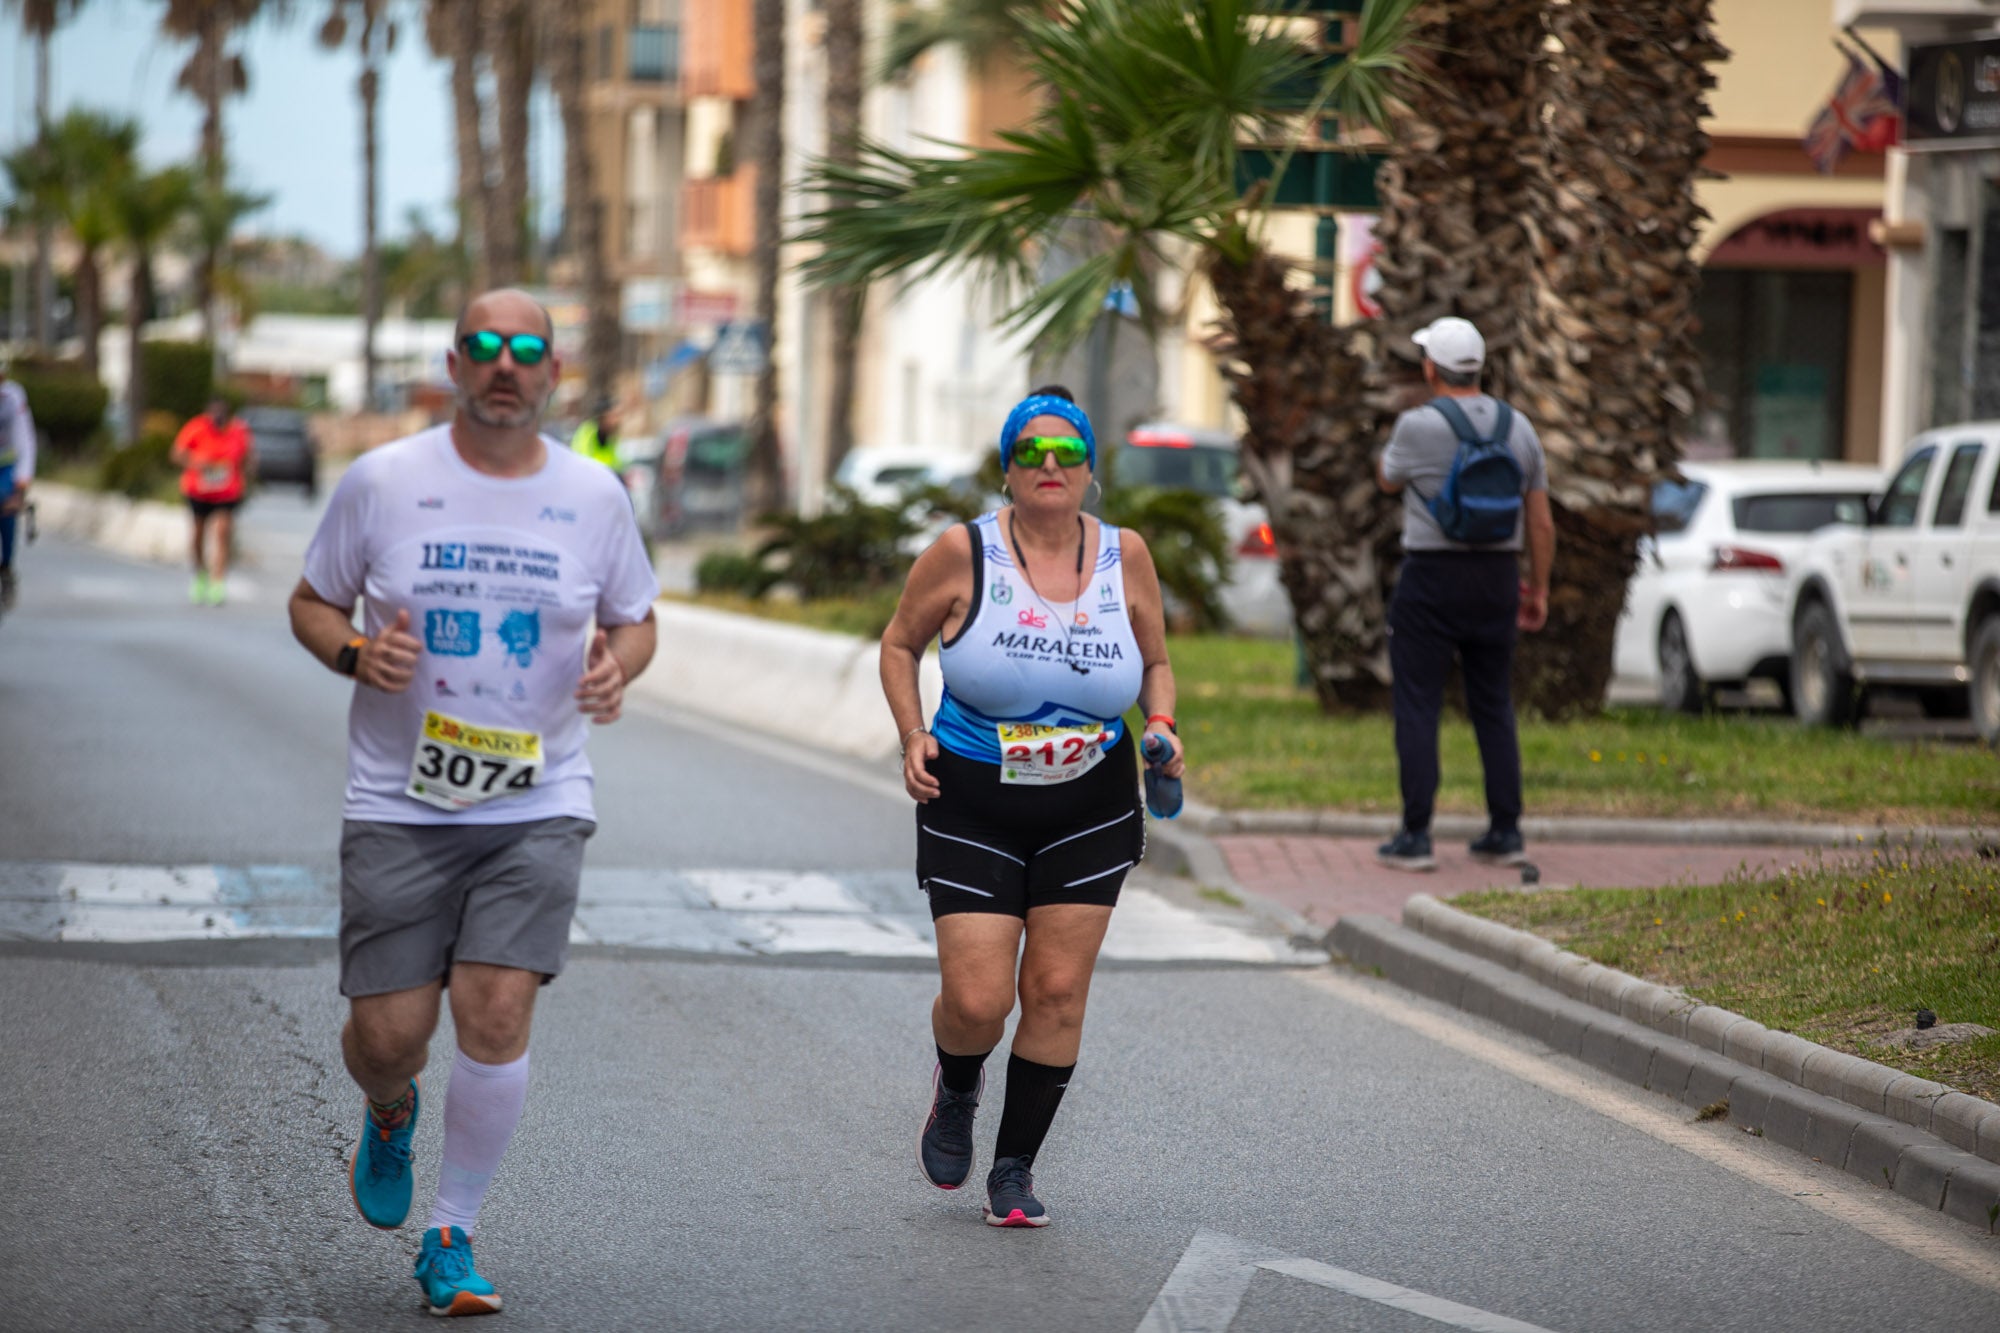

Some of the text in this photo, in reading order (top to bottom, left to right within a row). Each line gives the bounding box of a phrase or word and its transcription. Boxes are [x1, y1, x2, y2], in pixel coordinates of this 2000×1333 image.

[468, 557, 490, 573] DEL
[494, 559, 518, 576] AVE
[433, 611, 460, 640] 16
[992, 631, 1123, 660] MARACENA
[1006, 651, 1034, 660] CLUB
[1038, 655, 1052, 663] DE
[1014, 723, 1033, 738] 38
[417, 743, 536, 793] 3074
